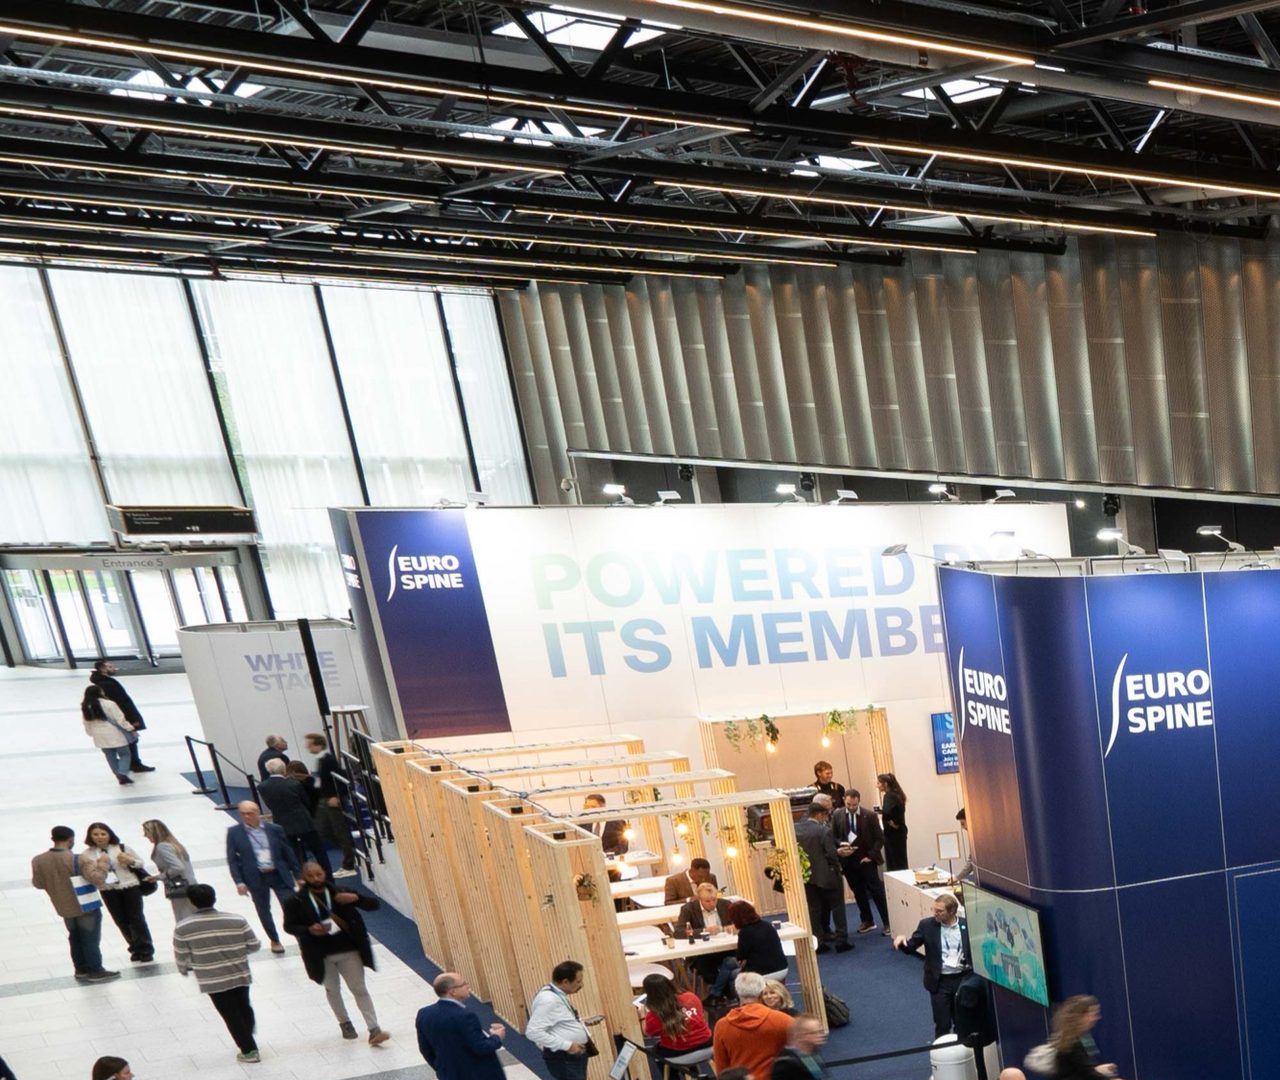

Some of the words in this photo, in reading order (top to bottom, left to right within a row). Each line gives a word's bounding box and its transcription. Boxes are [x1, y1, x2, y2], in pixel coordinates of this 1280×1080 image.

[103, 559, 153, 568] Entrance
[397, 555, 460, 572] EURO
[528, 546, 915, 611] POWERED
[400, 573, 464, 590] SPINE
[542, 618, 672, 678] ITS
[690, 604, 947, 670] MEMBE
[253, 671, 342, 692] STAE
[963, 668, 1007, 701] EURO
[1125, 669, 1210, 701] EURO
[967, 700, 1012, 735] SPINE
[1127, 701, 1213, 733] SPINE
